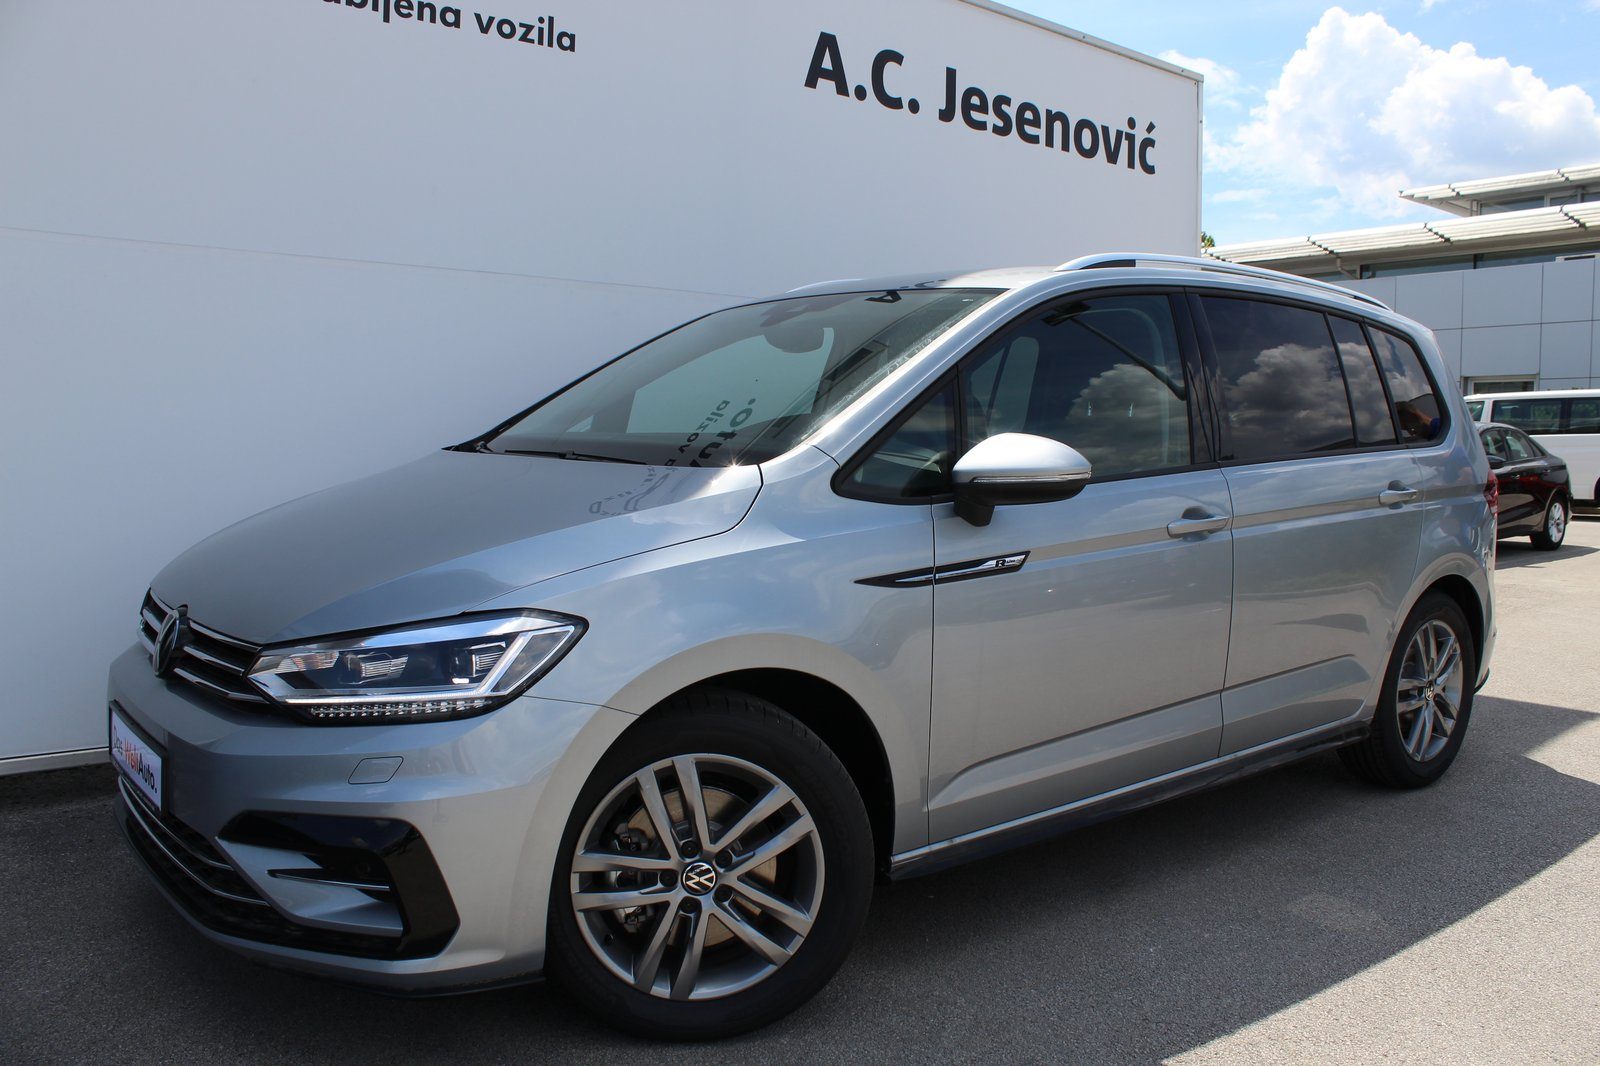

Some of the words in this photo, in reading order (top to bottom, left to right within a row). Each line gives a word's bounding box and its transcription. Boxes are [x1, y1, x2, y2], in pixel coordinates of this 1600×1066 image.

[322, 0, 461, 29] jena
[473, 12, 576, 52] vozila
[804, 31, 920, 115] A.C.
[938, 66, 1156, 175] Jesenović
